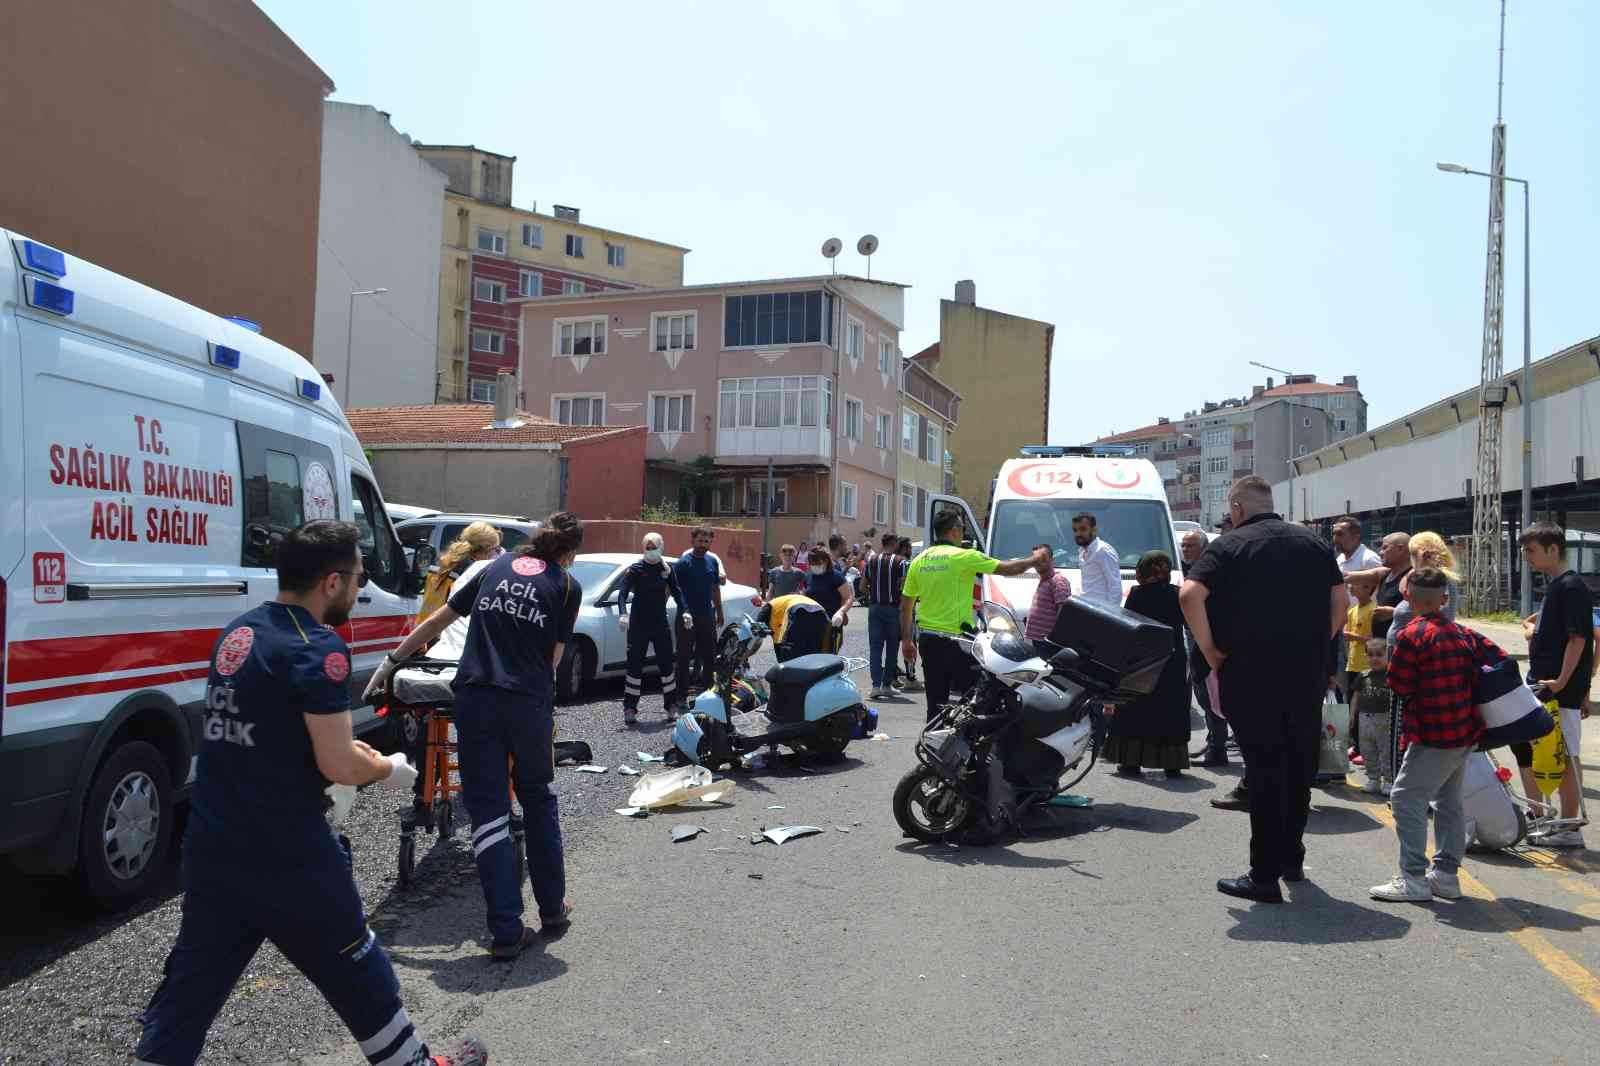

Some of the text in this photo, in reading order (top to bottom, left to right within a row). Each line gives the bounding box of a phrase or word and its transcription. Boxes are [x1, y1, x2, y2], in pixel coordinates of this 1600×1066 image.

[134, 415, 169, 456] T.C.
[50, 443, 233, 507] SAĞLIK BAKANLIĞI
[1034, 471, 1073, 484] 112
[90, 497, 209, 546] ACİL SAĞLIK
[38, 558, 62, 582] 112
[495, 579, 539, 603] ACİL
[478, 596, 548, 628] SAĞLIK
[202, 711, 257, 747] ĞLIK
